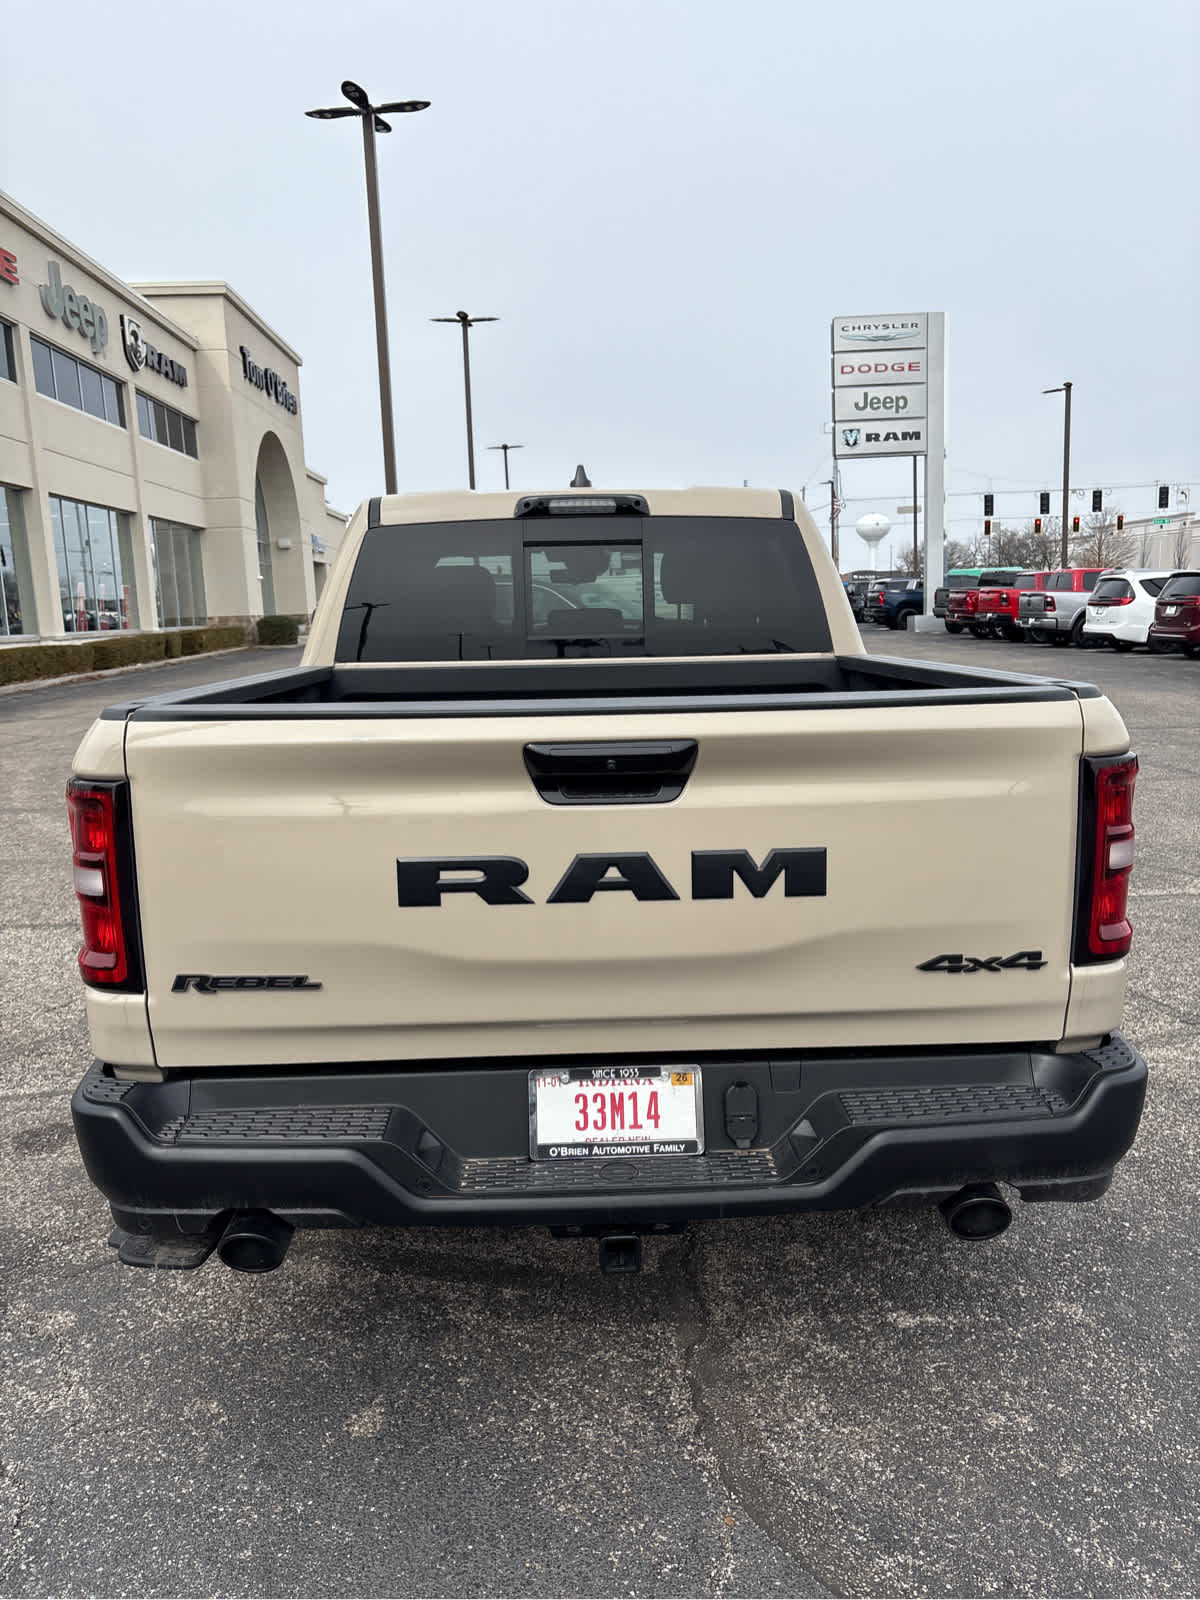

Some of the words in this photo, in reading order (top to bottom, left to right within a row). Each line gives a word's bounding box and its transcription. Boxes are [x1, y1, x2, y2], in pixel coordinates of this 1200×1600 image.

[39, 261, 108, 354] Jeep
[841, 322, 919, 332] CHRYSLER
[144, 342, 188, 388] RAM
[840, 361, 921, 375] DODGE
[240, 346, 263, 391] Tom
[264, 368, 297, 415] O'Brien
[854, 391, 908, 414] Jeep
[865, 430, 921, 442] RAM
[397, 847, 827, 908] RAM
[915, 950, 1048, 973] 4x4
[171, 974, 323, 994] REBEL
[592, 1068, 615, 1079] SINCE
[574, 1090, 660, 1132] 33M14
